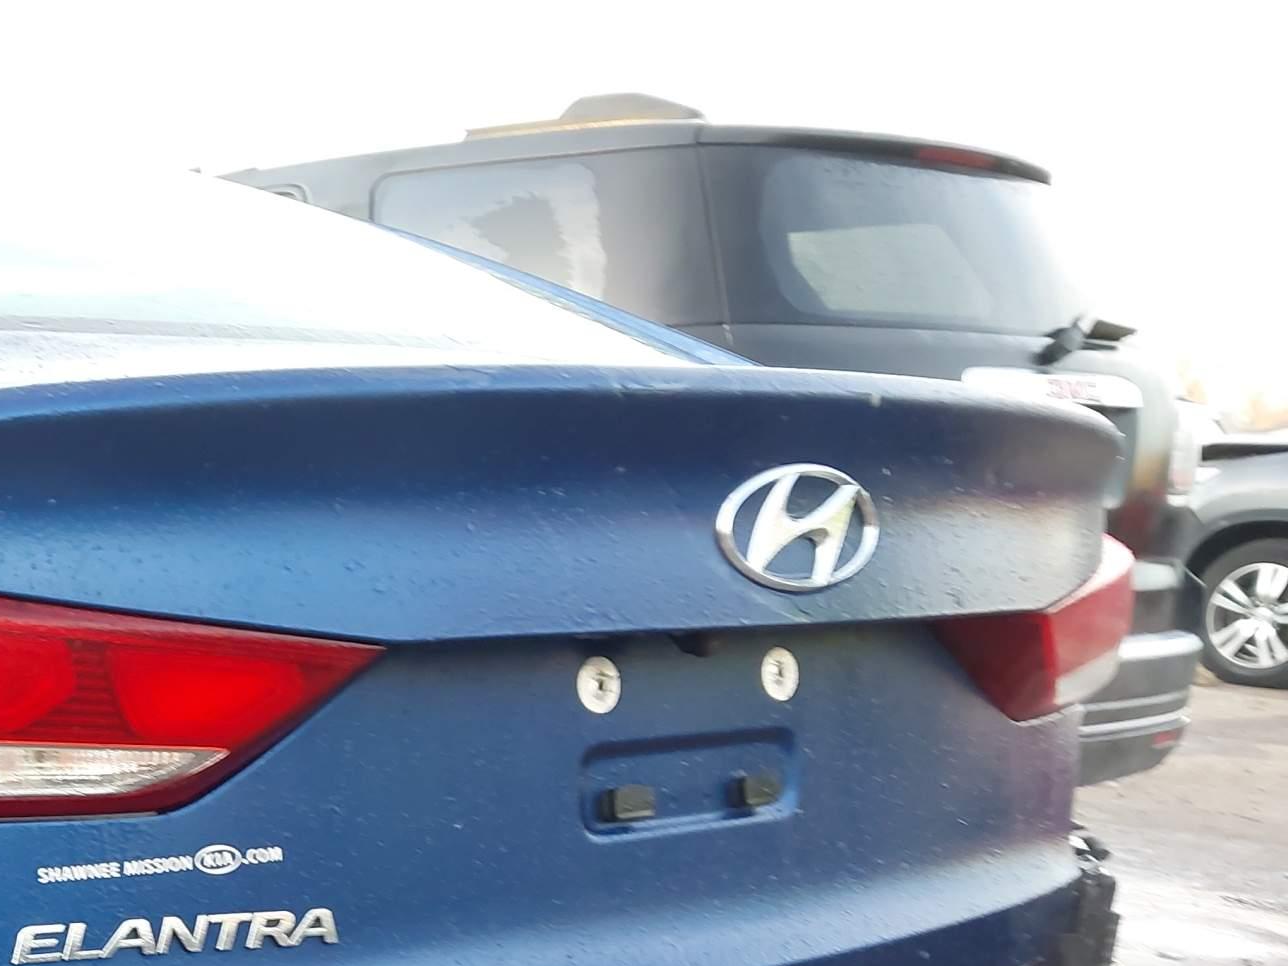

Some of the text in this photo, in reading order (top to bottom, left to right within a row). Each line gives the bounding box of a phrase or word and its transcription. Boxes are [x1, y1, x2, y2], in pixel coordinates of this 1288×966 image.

[37, 861, 121, 884] SHAWNEE
[123, 856, 193, 876] MISSION
[10, 908, 340, 966] ELANTRA
